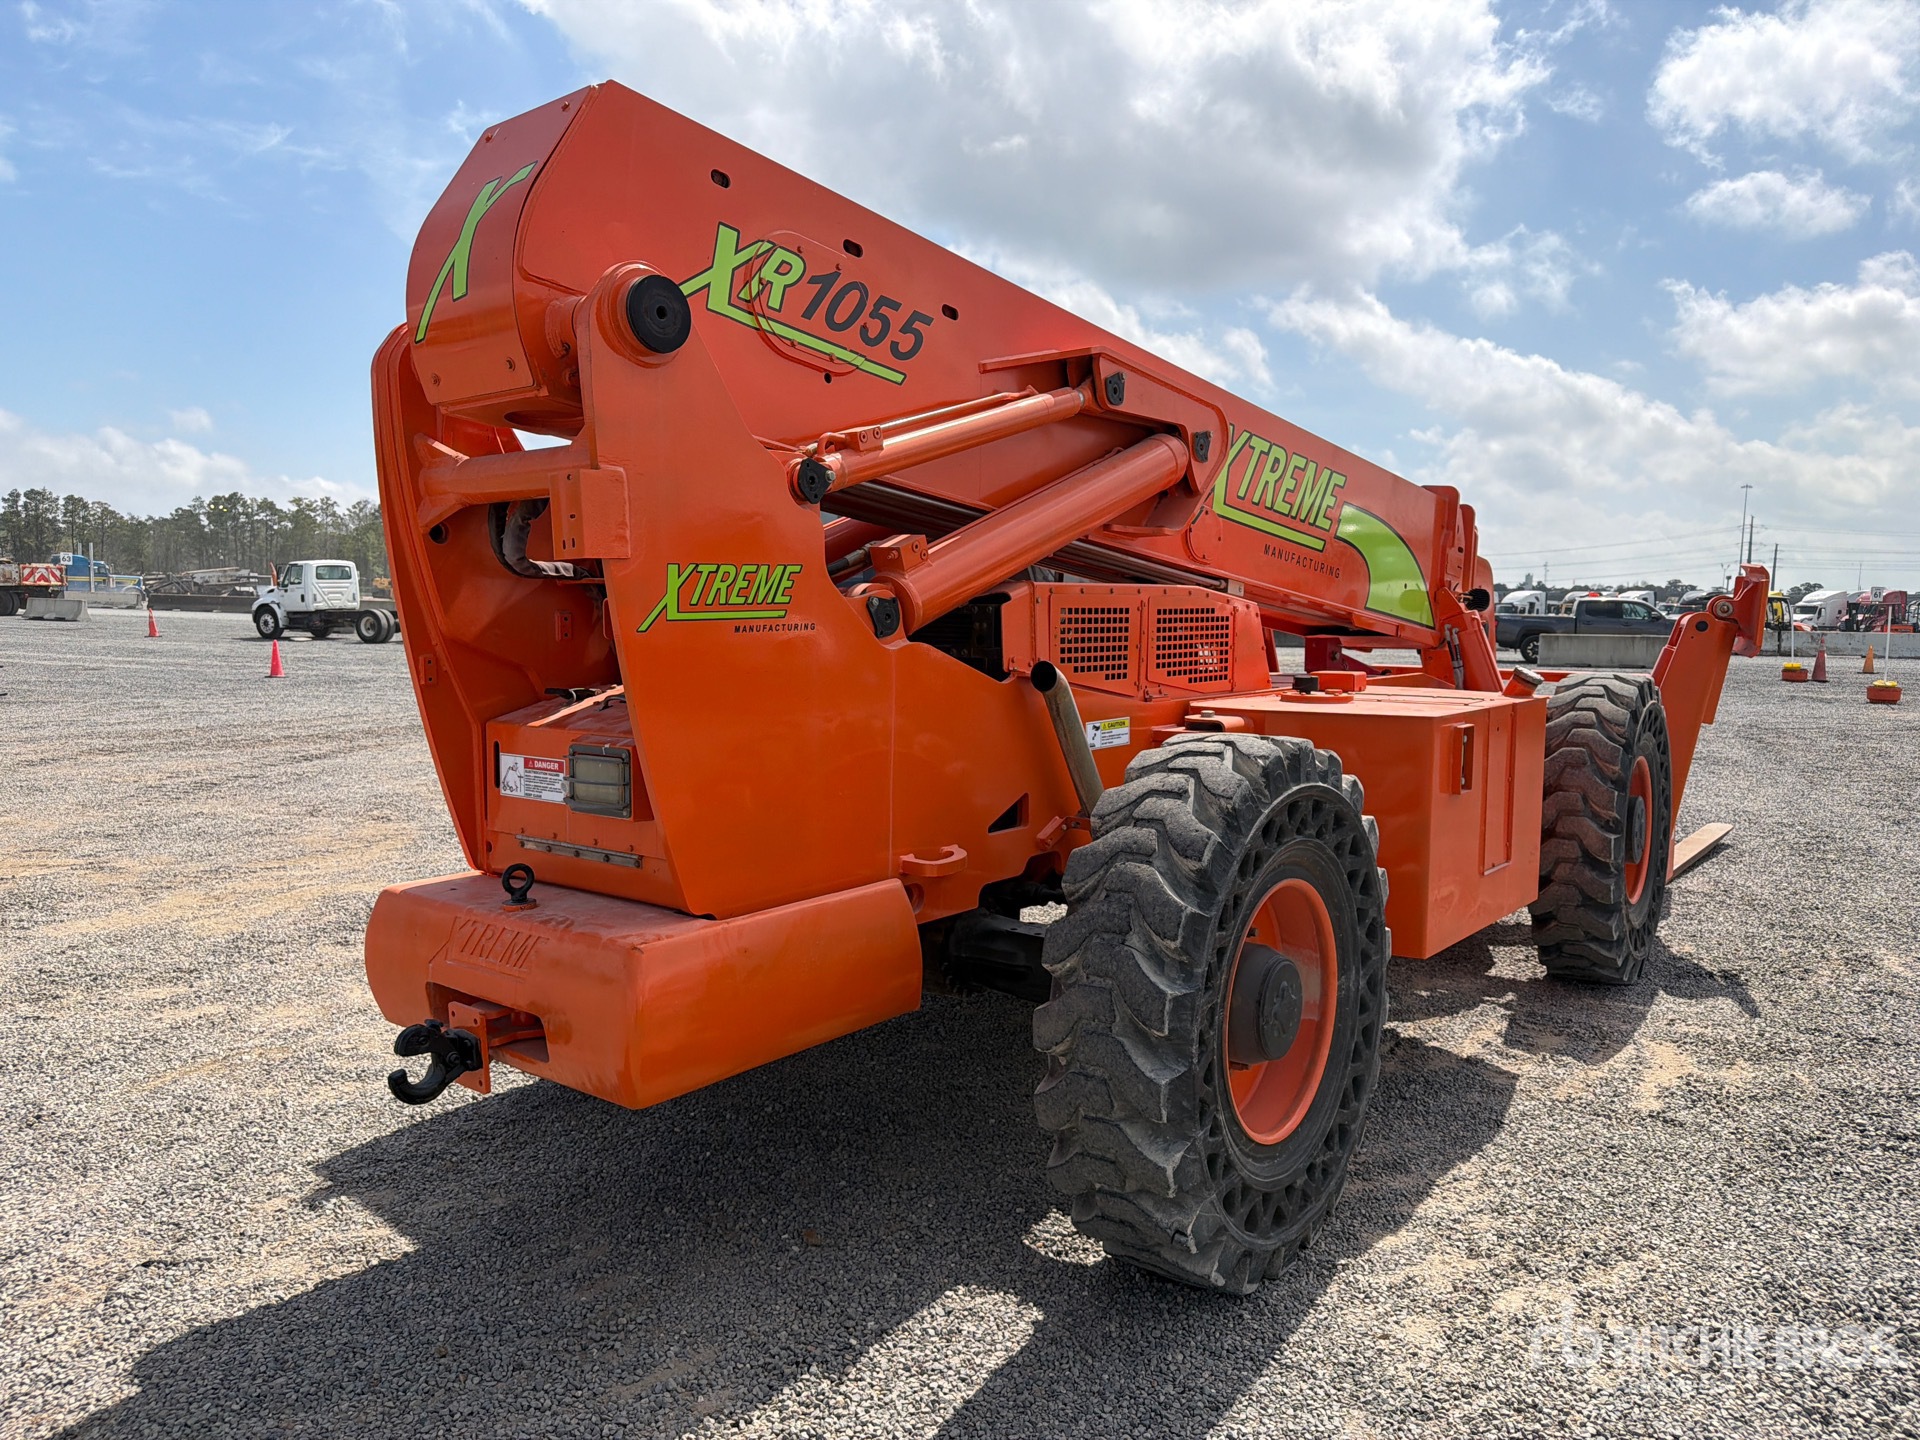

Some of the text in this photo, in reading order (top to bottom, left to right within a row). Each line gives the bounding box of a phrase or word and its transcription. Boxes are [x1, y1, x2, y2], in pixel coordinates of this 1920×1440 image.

[1198, 423, 1347, 550] XTREME
[61, 555, 72, 563] 63
[1263, 543, 1341, 579] MANUFACTURING
[636, 562, 803, 633] XTREME
[1873, 591, 1882, 599] 61
[734, 622, 816, 634] MANUFACTURING
[1107, 720, 1126, 728] CAUTION
[534, 760, 559, 770] DANGER
[428, 915, 551, 978] XTREME
